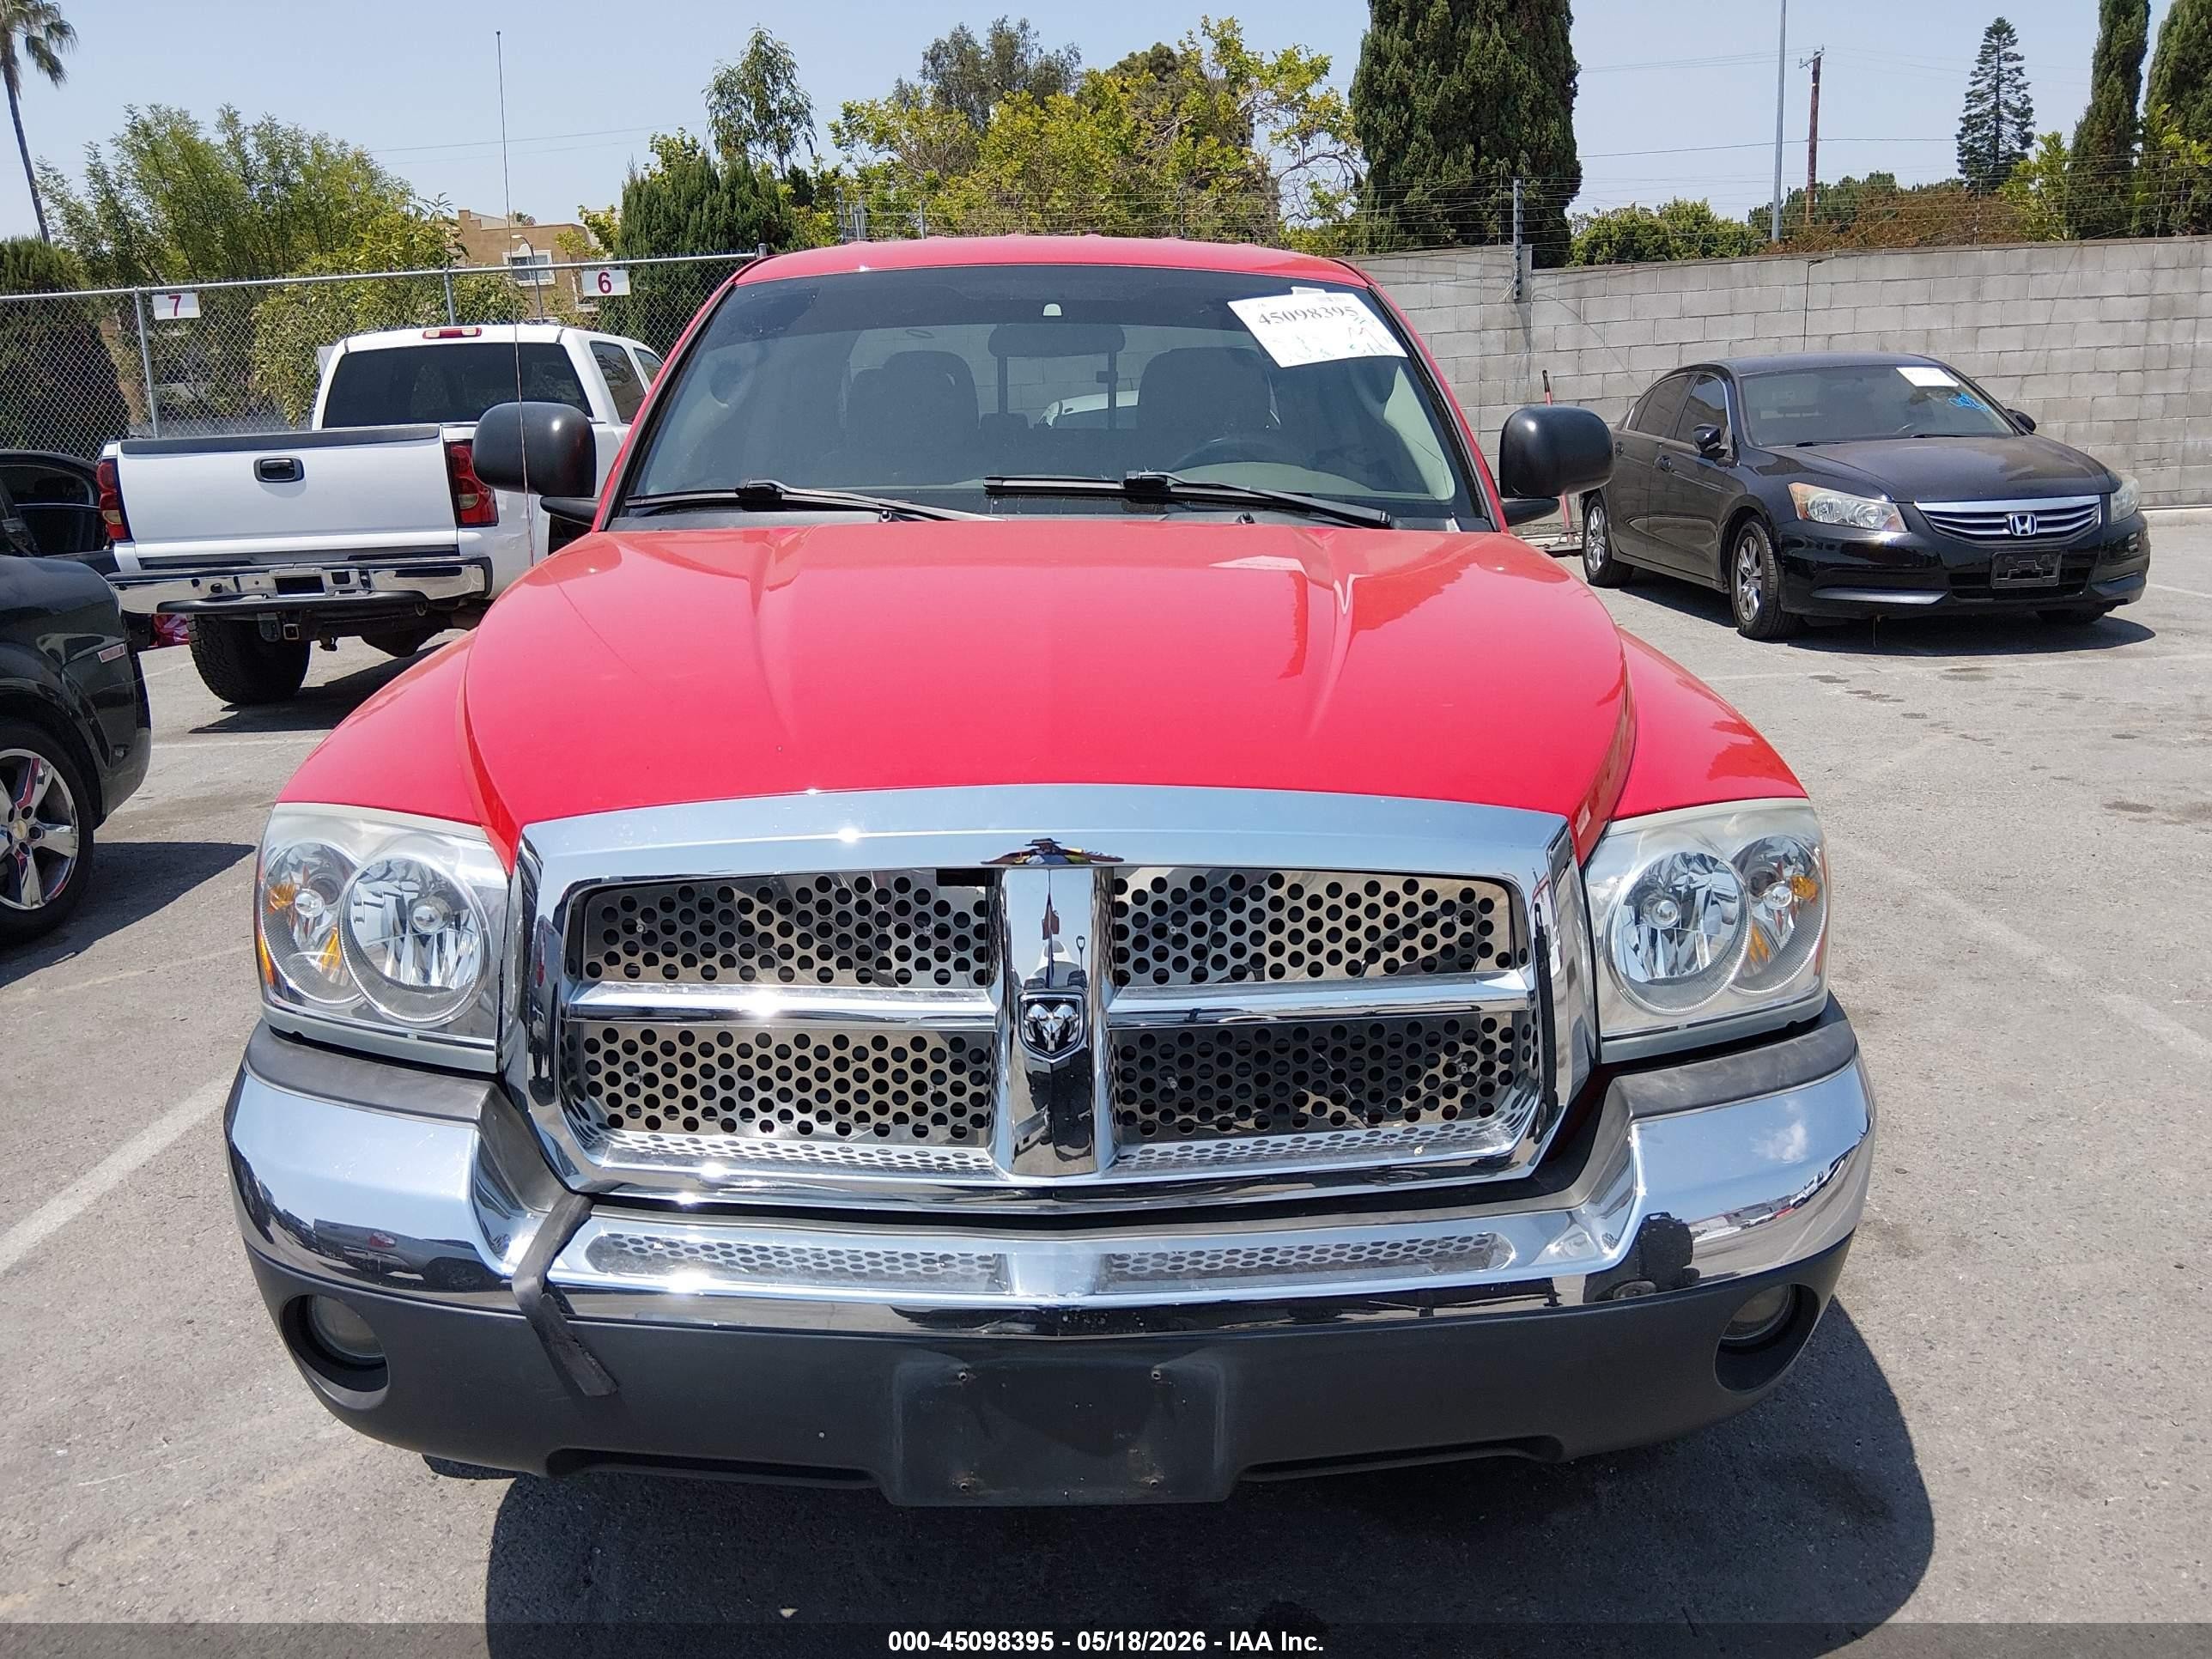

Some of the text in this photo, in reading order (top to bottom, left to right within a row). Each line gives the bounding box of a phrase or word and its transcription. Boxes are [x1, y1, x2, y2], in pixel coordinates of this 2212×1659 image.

[598, 271, 612, 295] 6
[167, 295, 182, 317] 7
[1258, 305, 1359, 325] 45098395
